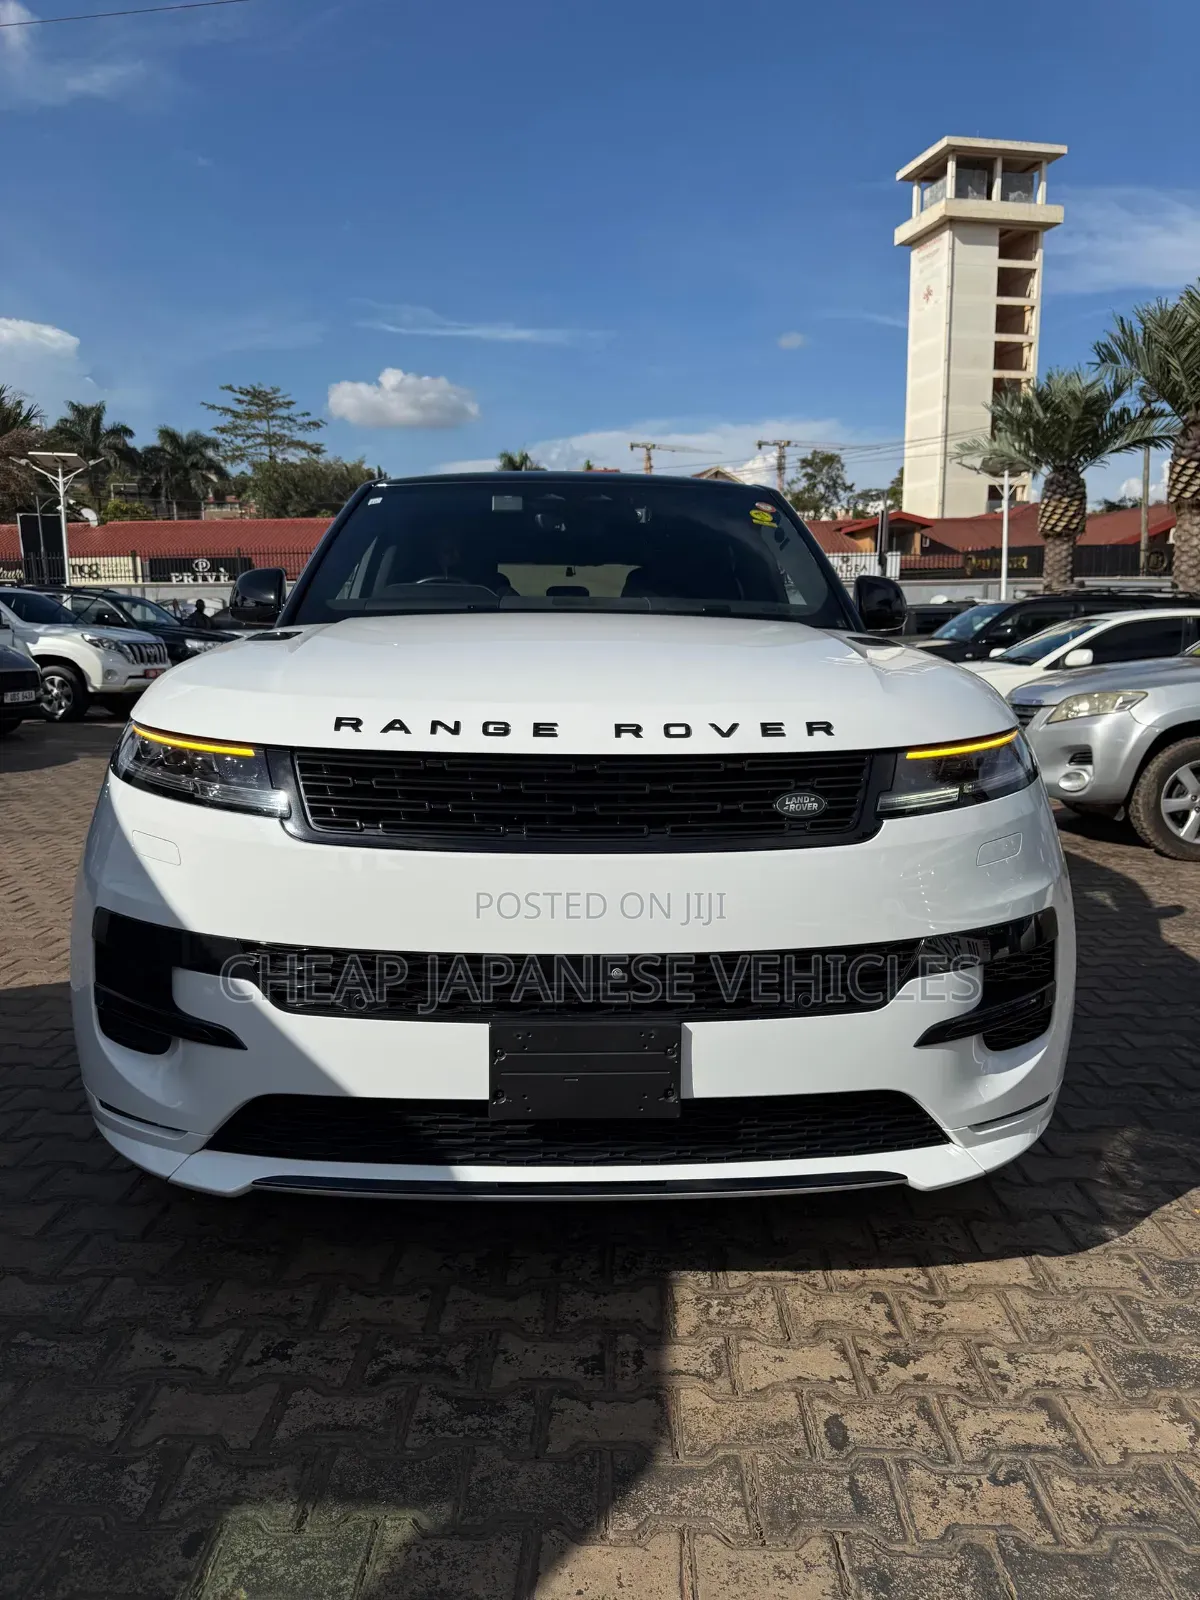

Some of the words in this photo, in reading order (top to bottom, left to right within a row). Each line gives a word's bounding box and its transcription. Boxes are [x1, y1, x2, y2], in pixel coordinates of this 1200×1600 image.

[334, 716, 560, 738] RANGE
[614, 721, 836, 739] ROVER
[785, 796, 810, 805] LAND
[789, 803, 818, 812] ROVER
